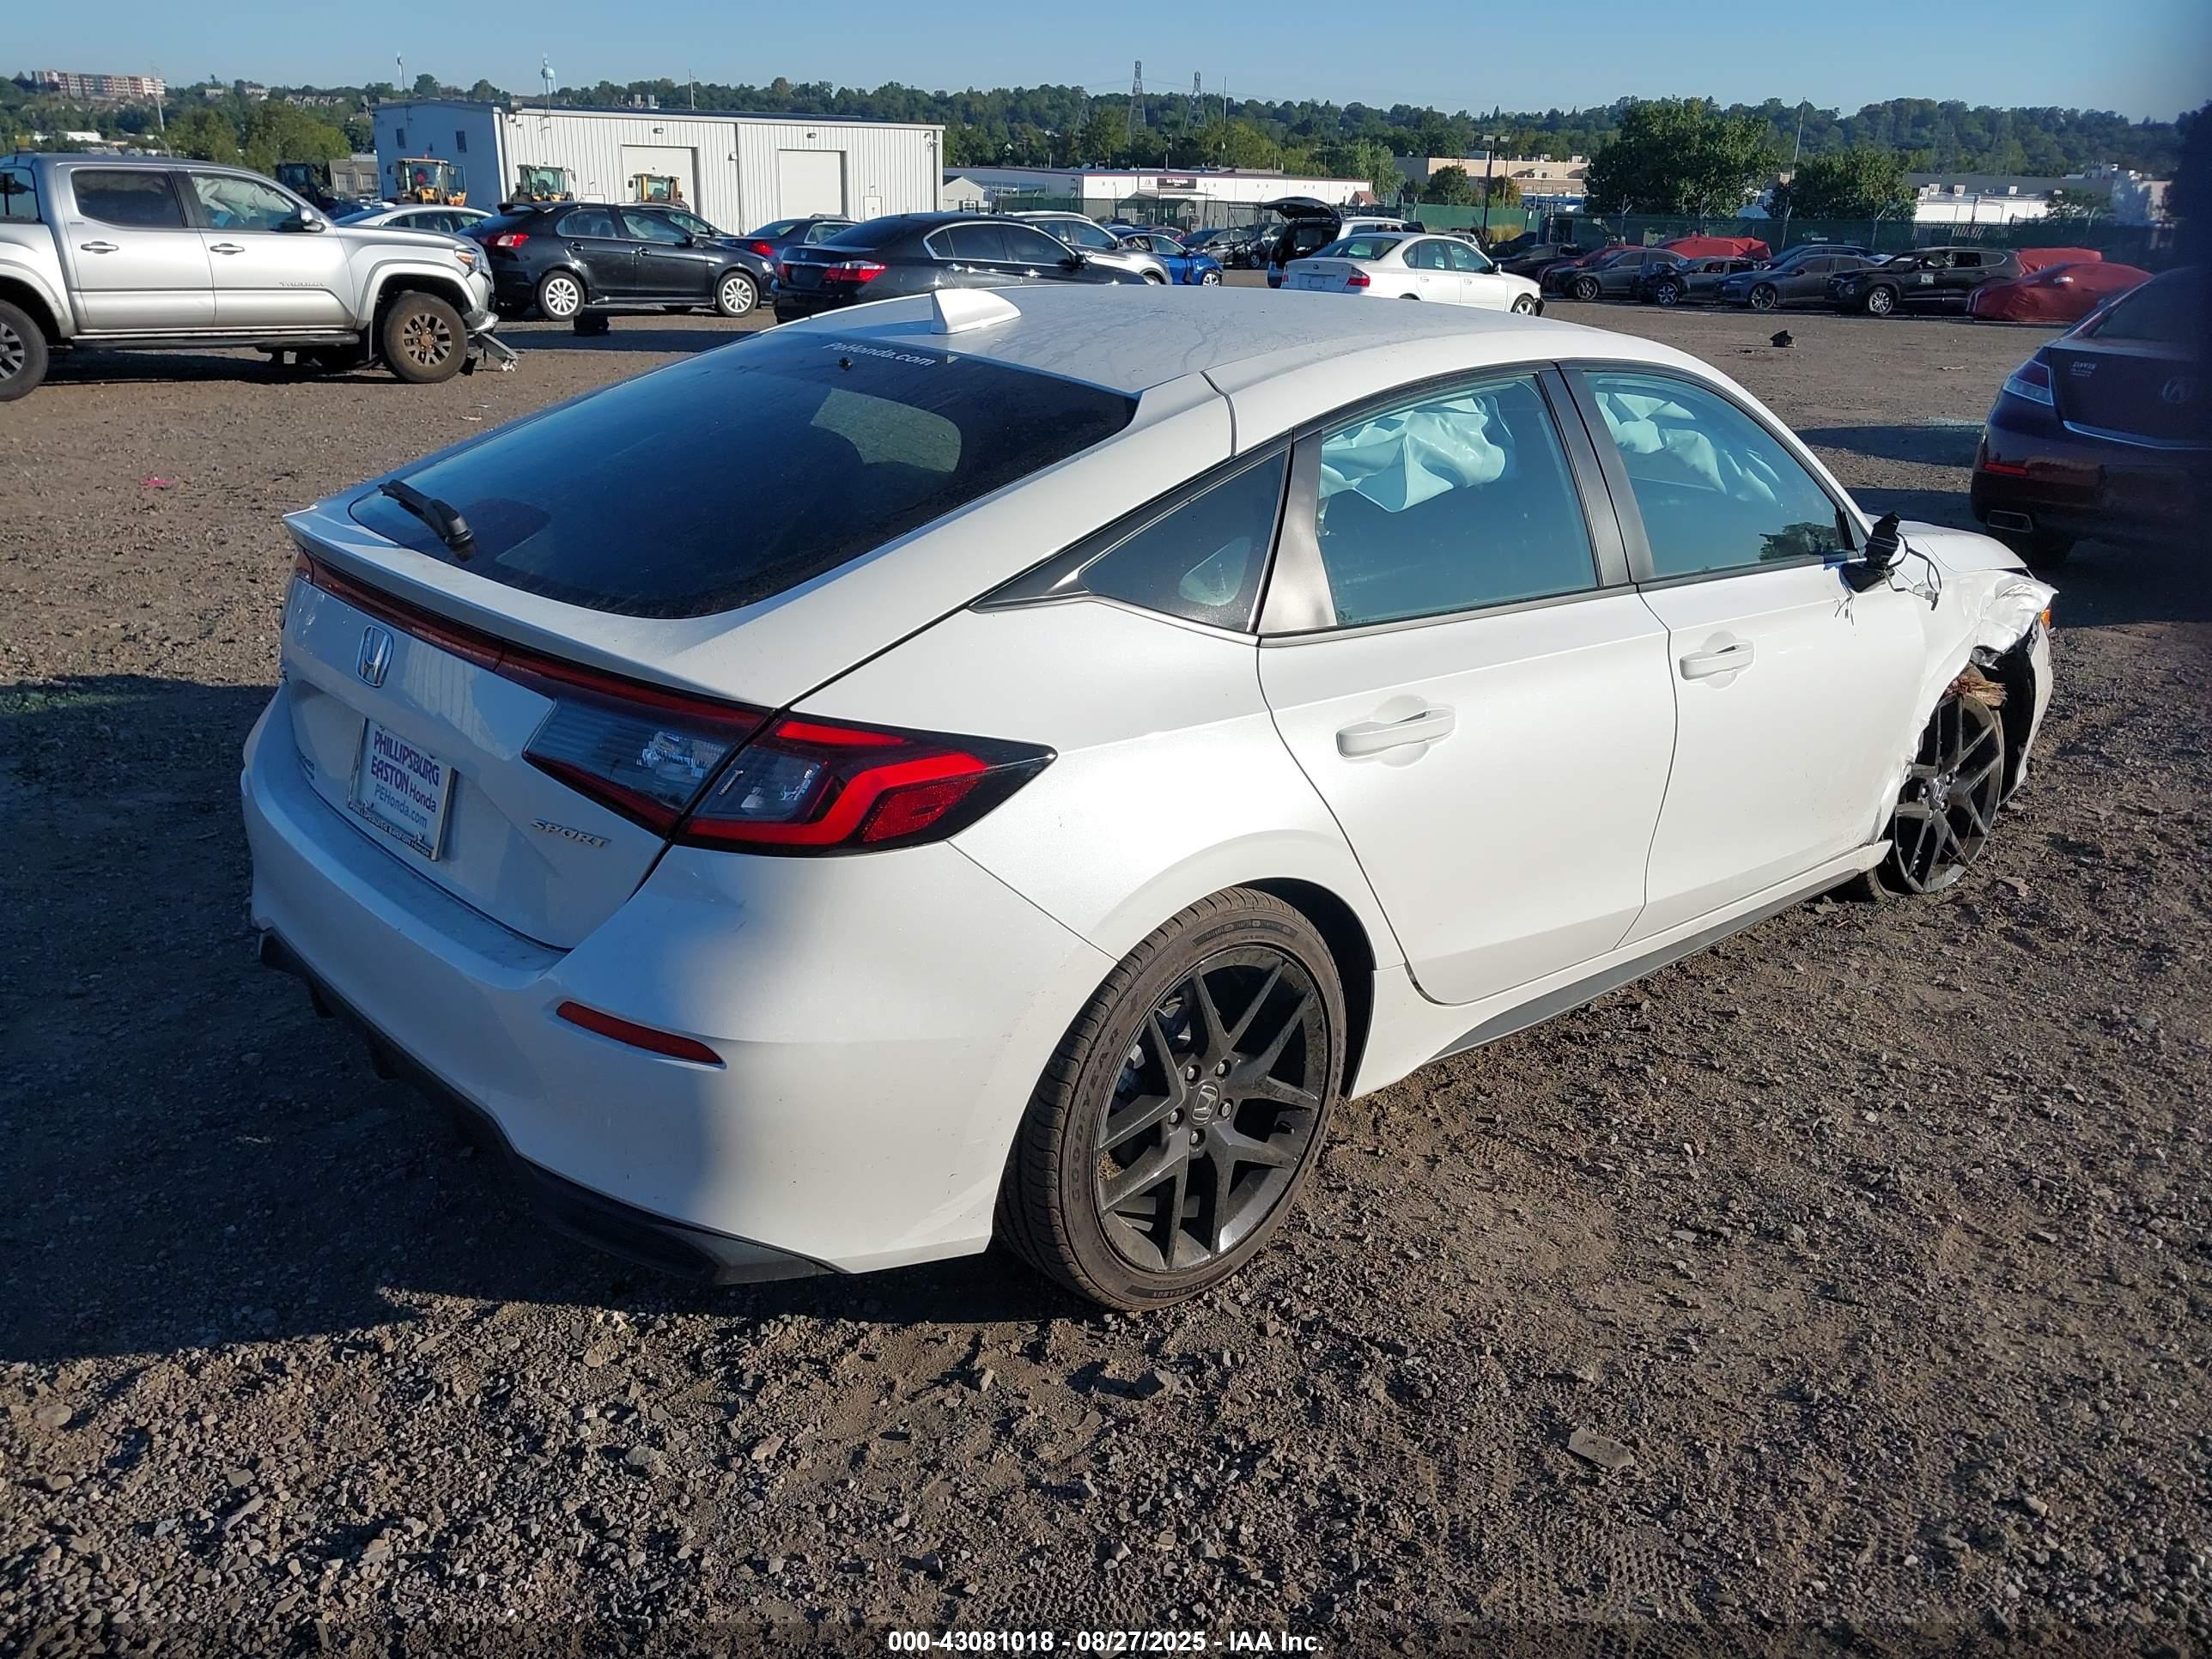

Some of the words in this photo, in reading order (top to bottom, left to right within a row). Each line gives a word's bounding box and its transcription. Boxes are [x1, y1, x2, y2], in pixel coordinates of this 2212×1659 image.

[823, 343, 937, 366] PeHonda.com
[373, 731, 440, 787] PHILLIPSBURG
[371, 755, 410, 794] EASTON
[410, 783, 437, 812] Honda
[374, 784, 428, 828] PEHonda.com
[530, 818, 611, 847] SPORT
